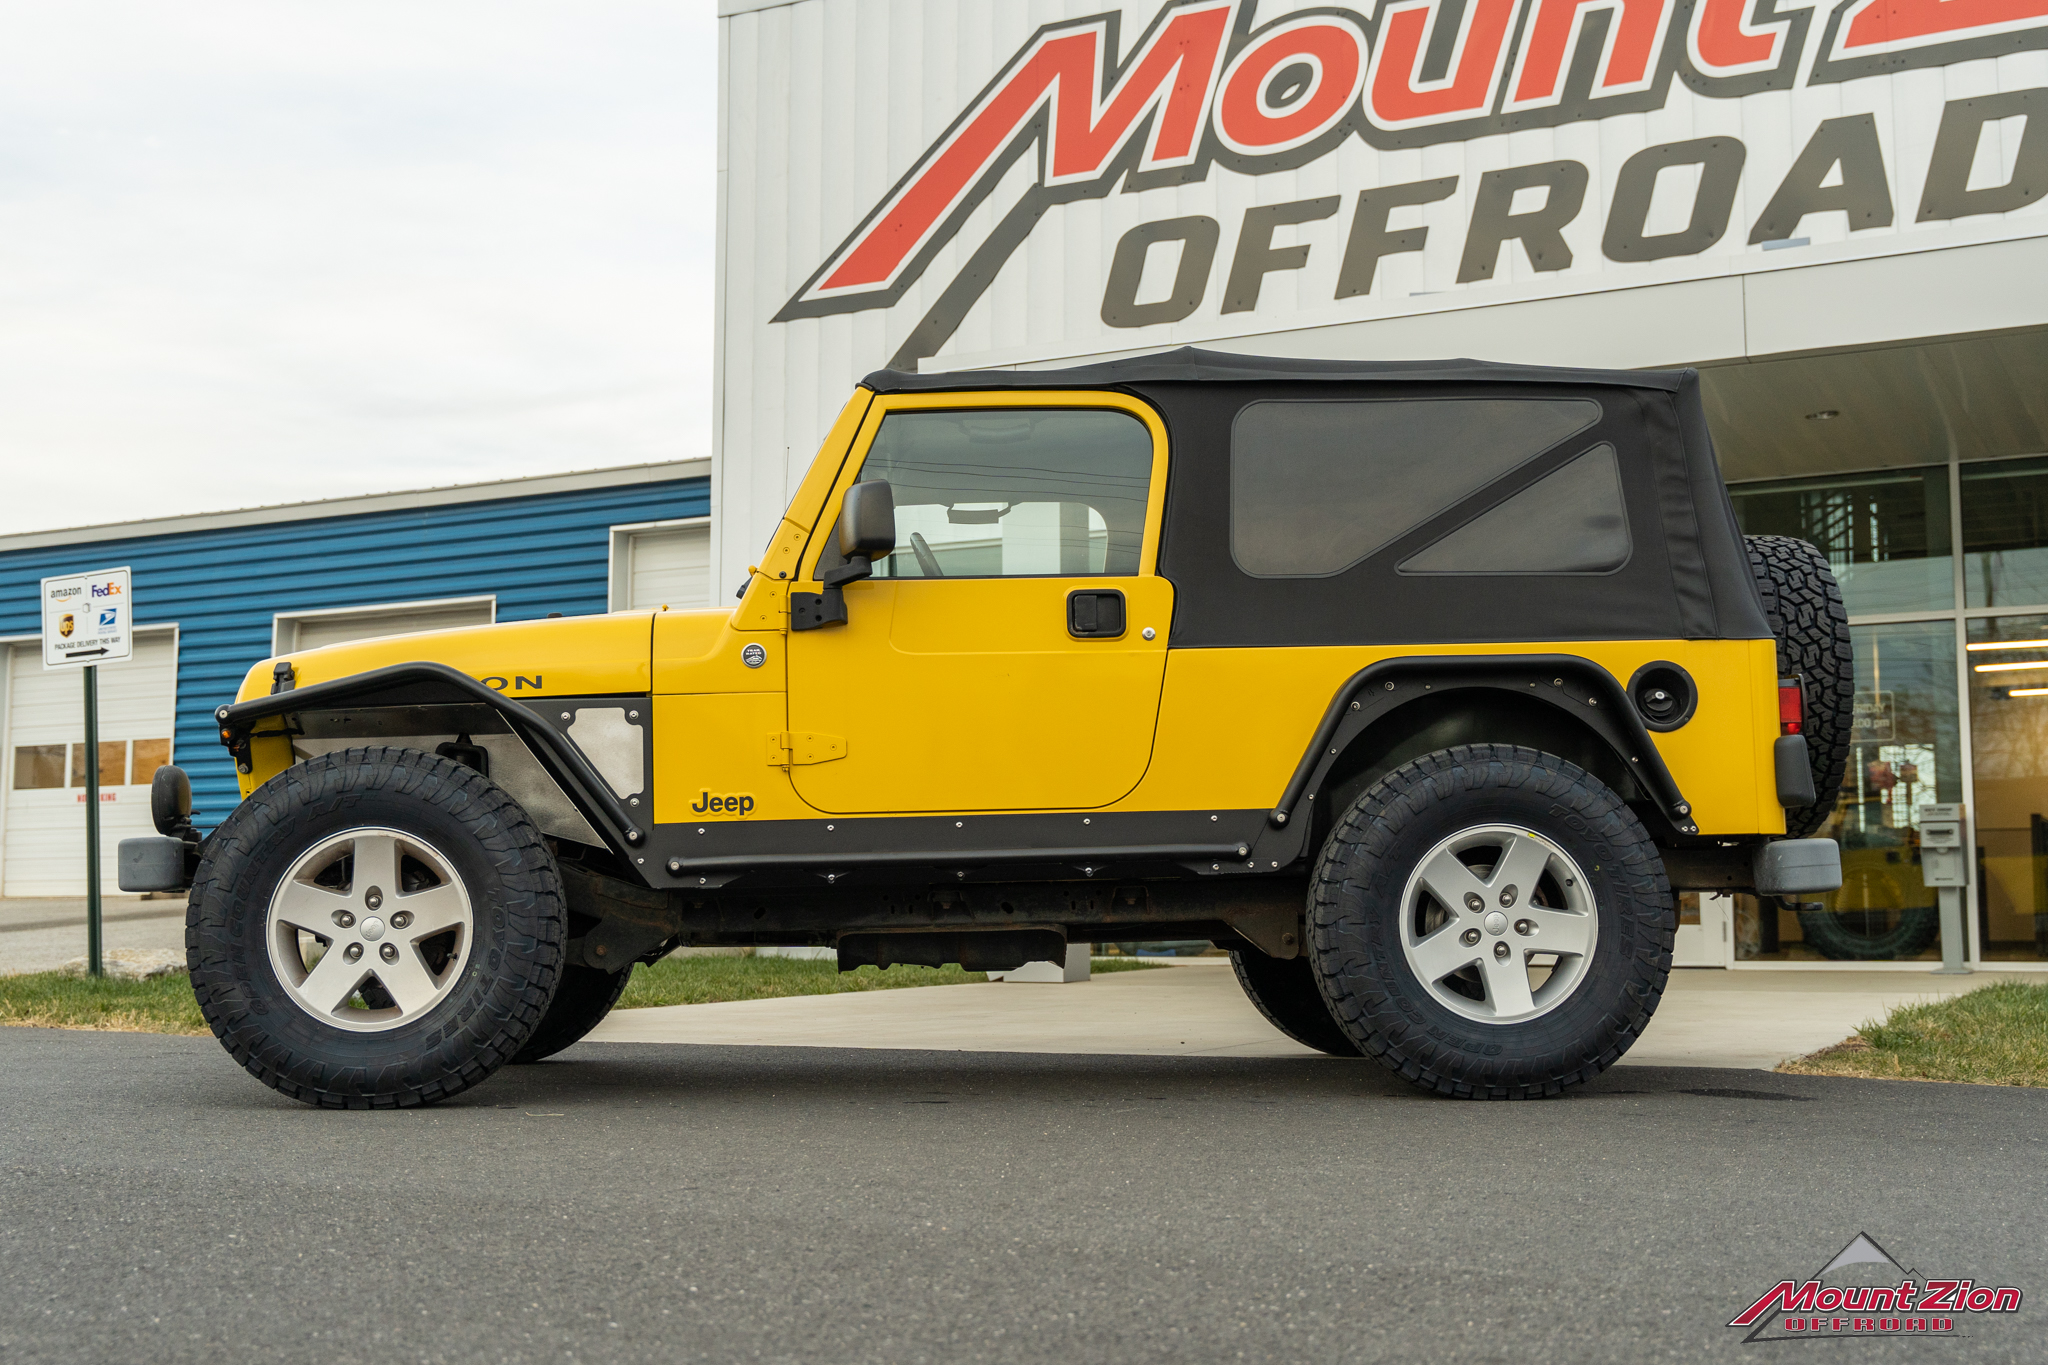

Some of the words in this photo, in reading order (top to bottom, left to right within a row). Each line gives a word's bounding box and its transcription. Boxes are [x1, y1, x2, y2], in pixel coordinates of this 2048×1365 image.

[1100, 88, 2048, 328] OFFROAD
[50, 586, 82, 598] amazon
[91, 581, 122, 598] FedEx
[54, 642, 76, 650] PACKAGE
[76, 639, 98, 648] DELIVERY
[99, 637, 110, 645] THIS
[692, 792, 754, 816] Jeep
[1549, 803, 1615, 862] TOYO
